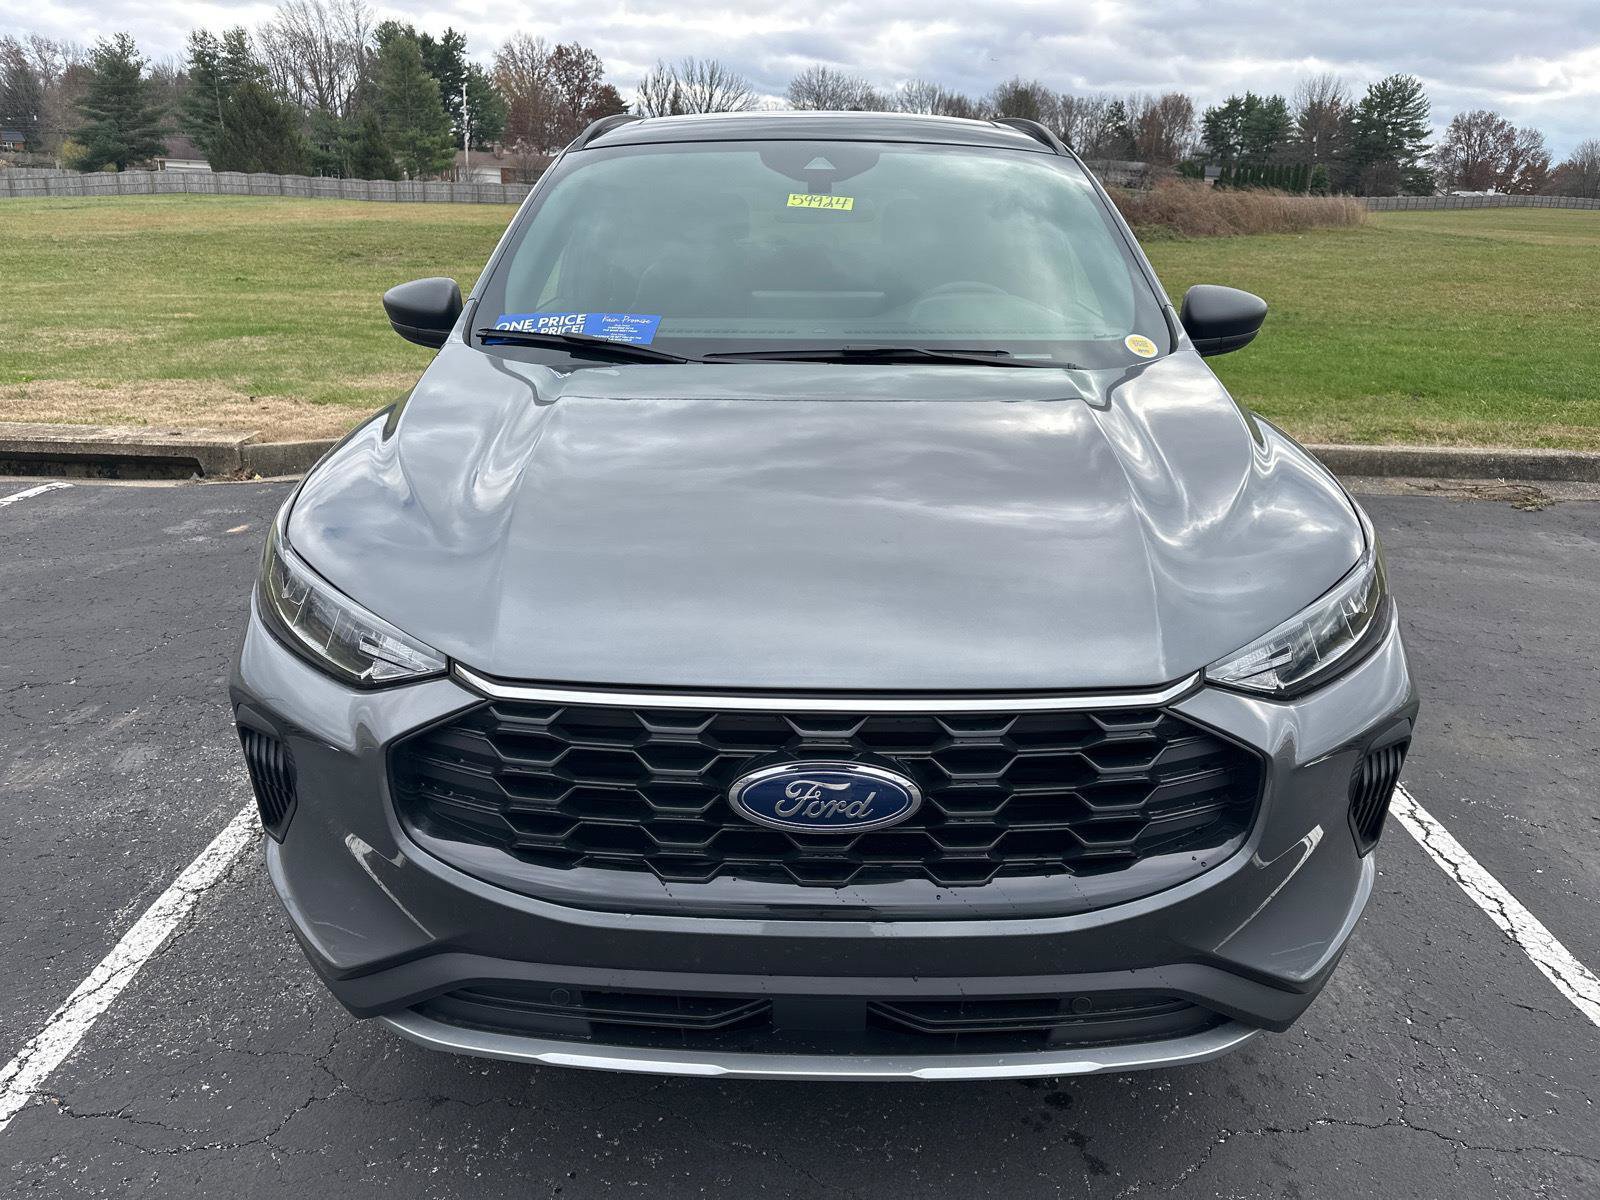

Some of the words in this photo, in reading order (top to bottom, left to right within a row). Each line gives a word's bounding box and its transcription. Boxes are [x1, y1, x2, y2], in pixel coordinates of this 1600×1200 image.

[791, 195, 848, 208] 59924
[495, 319, 535, 331] ONE
[538, 313, 587, 328] PRICE
[774, 780, 877, 819] Ford
